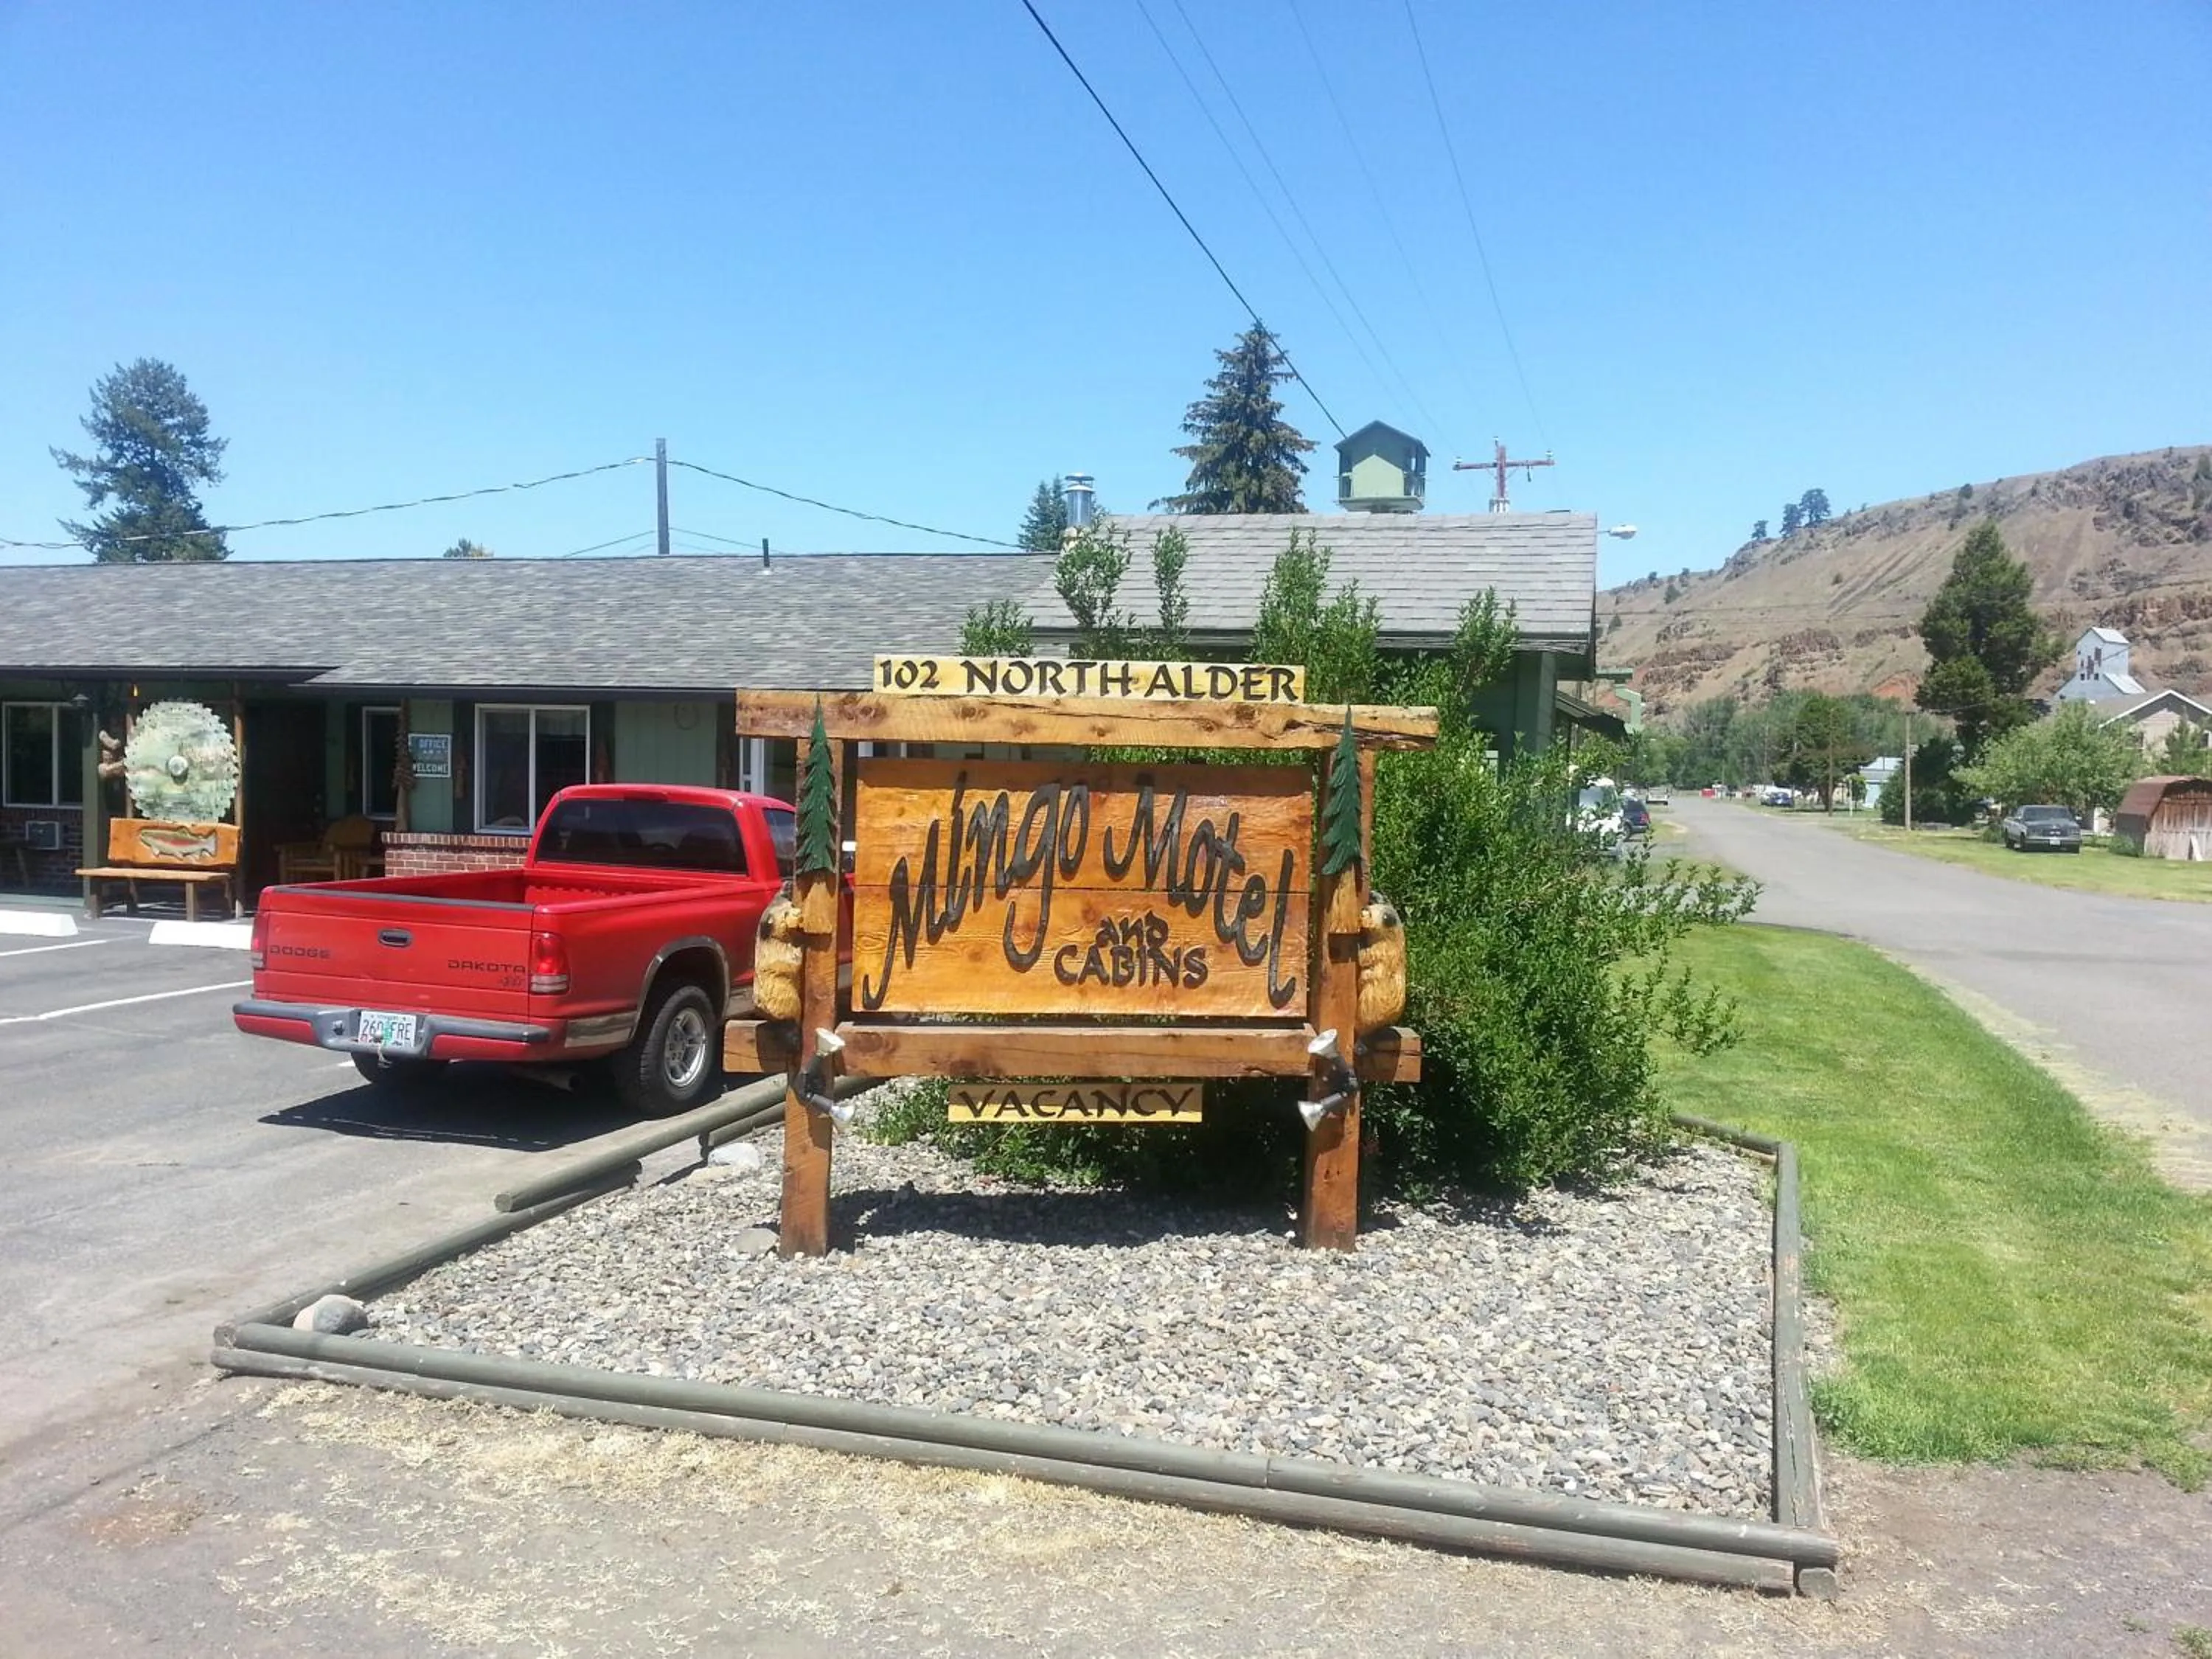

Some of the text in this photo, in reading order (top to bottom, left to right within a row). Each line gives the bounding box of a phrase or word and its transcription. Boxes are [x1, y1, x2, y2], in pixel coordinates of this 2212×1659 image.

[880, 659, 1298, 701] 102 NORTH ALDER
[863, 771, 1296, 1010] Mingo Motel
[269, 945, 330, 959] DODGE
[448, 959, 526, 973] DAKOTA
[1054, 945, 1208, 989] CABINS
[391, 1021, 411, 1040] FRE
[959, 1087, 1194, 1118] VACANCY
